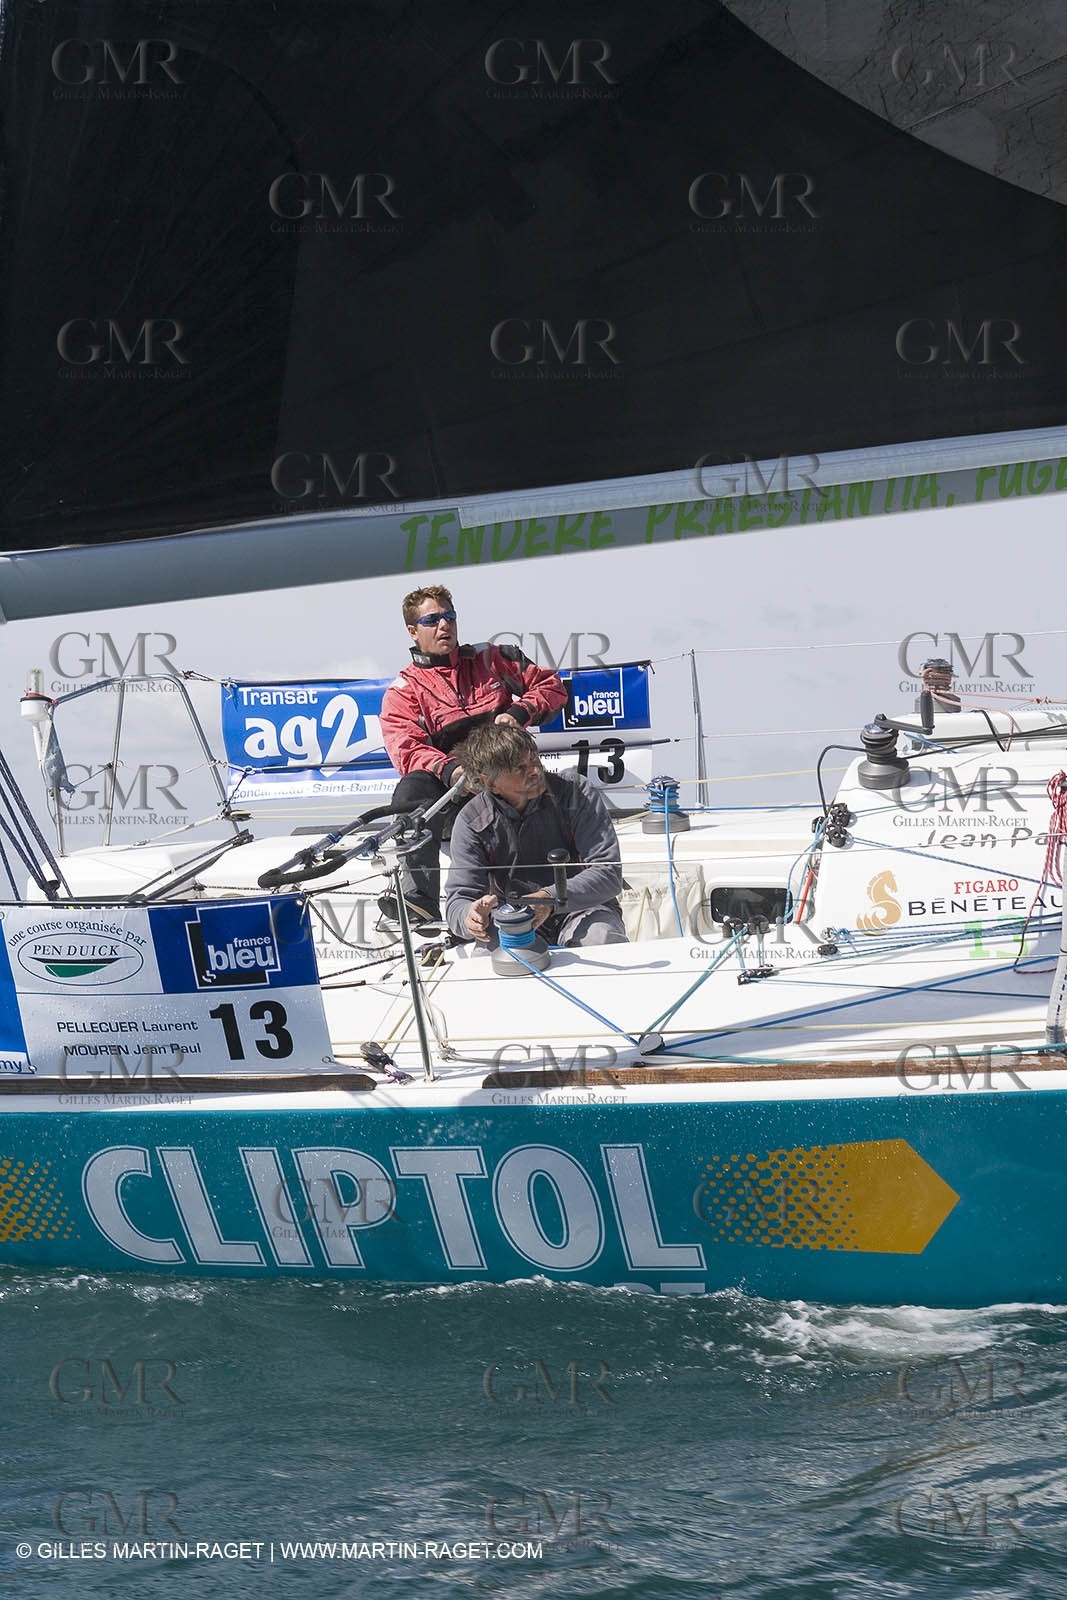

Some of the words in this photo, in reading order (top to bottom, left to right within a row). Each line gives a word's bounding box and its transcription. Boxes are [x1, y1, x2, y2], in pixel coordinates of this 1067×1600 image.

[401, 510, 617, 573] TENDERE
[238, 687, 318, 706] Transat
[574, 694, 621, 716] bleu
[592, 690, 620, 699] france
[570, 737, 626, 784] 13
[918, 829, 997, 849] Jean
[953, 878, 1019, 895] FIGARO
[8, 929, 26, 947] une
[27, 920, 62, 935] course
[65, 919, 123, 936] organisée
[124, 930, 147, 948] par
[232, 936, 271, 948] france
[963, 913, 1029, 958] 13
[33, 944, 62, 956] PEN
[67, 944, 120, 956] DUICK
[207, 944, 276, 971] bleu
[143, 1020, 199, 1032] Laurent
[209, 1000, 294, 1061] 13
[64, 1044, 130, 1056] MOUREN
[133, 1044, 167, 1055] Jean
[170, 1042, 202, 1054] Paul
[81, 1143, 707, 1272] CLIPTOL
